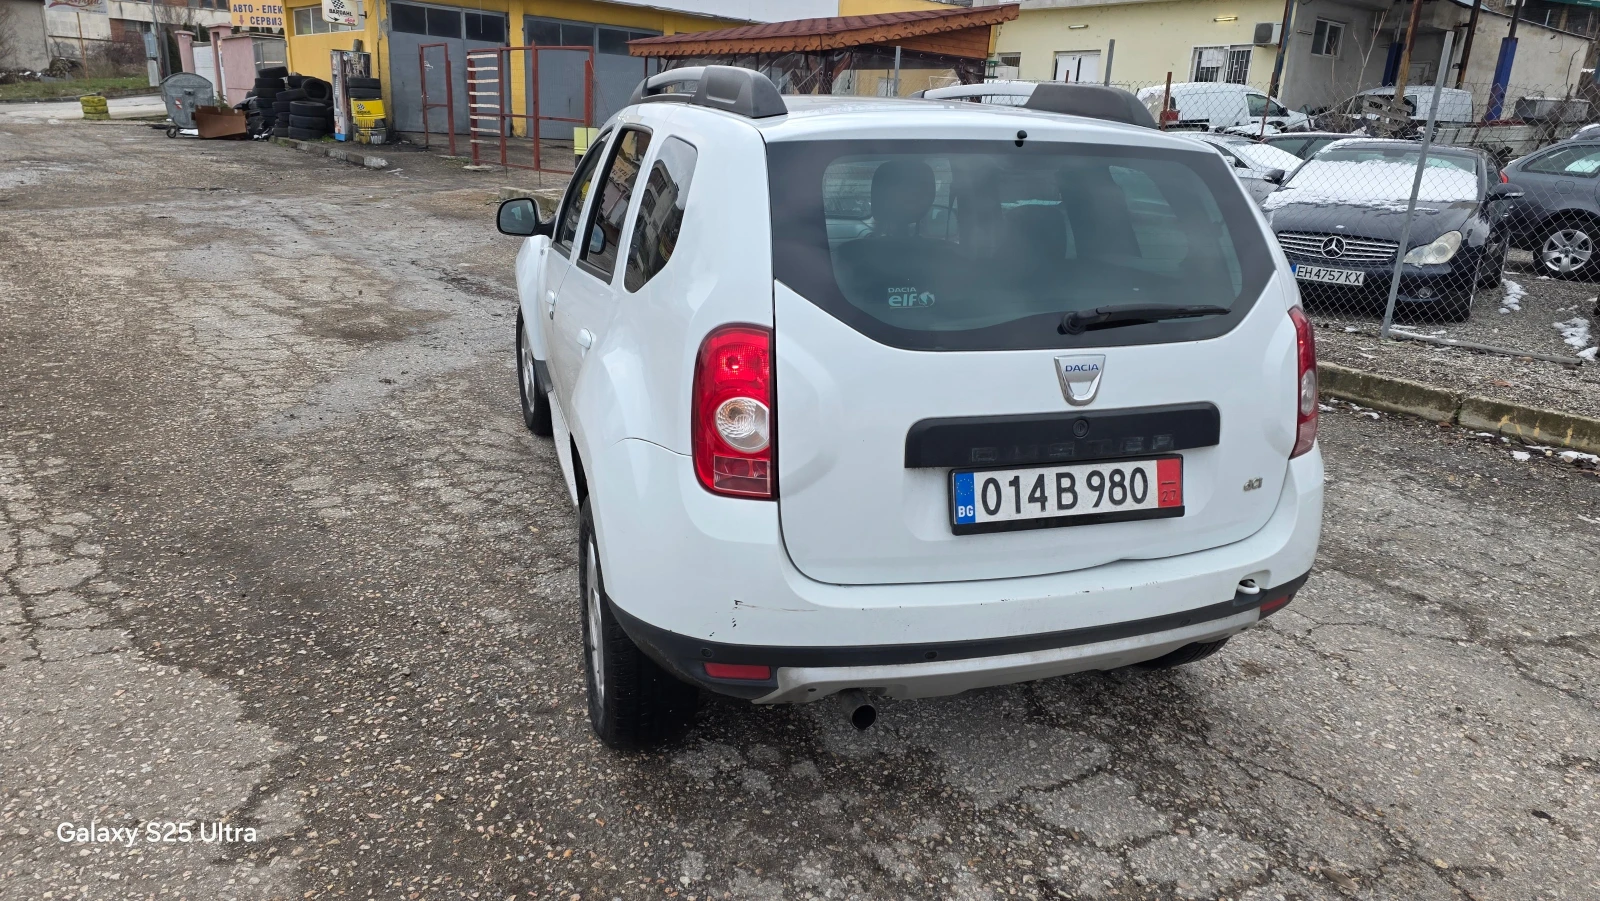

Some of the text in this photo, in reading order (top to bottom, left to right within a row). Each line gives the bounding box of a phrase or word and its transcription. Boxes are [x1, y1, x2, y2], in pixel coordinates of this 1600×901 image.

[233, 4, 254, 13] АВТО
[250, 16, 283, 26] СЕРВИЗ
[888, 293, 917, 307] elf
[1065, 363, 1099, 372] DACIA
[958, 505, 974, 518] BG
